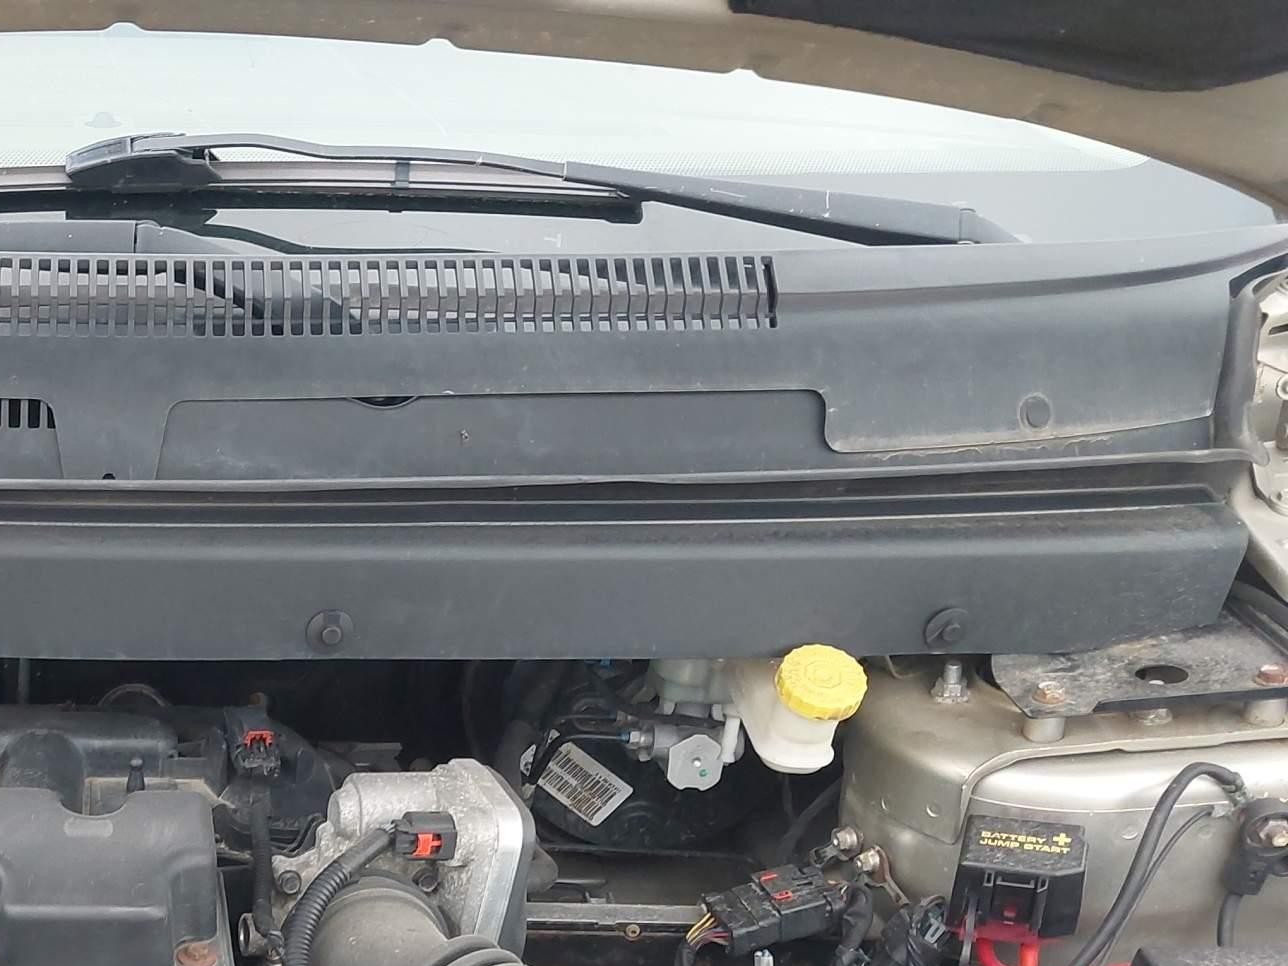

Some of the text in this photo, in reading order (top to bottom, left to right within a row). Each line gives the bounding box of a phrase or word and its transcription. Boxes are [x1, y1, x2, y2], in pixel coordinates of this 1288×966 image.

[981, 831, 1047, 844] BATTERY
[979, 838, 1071, 854] JUMP START
